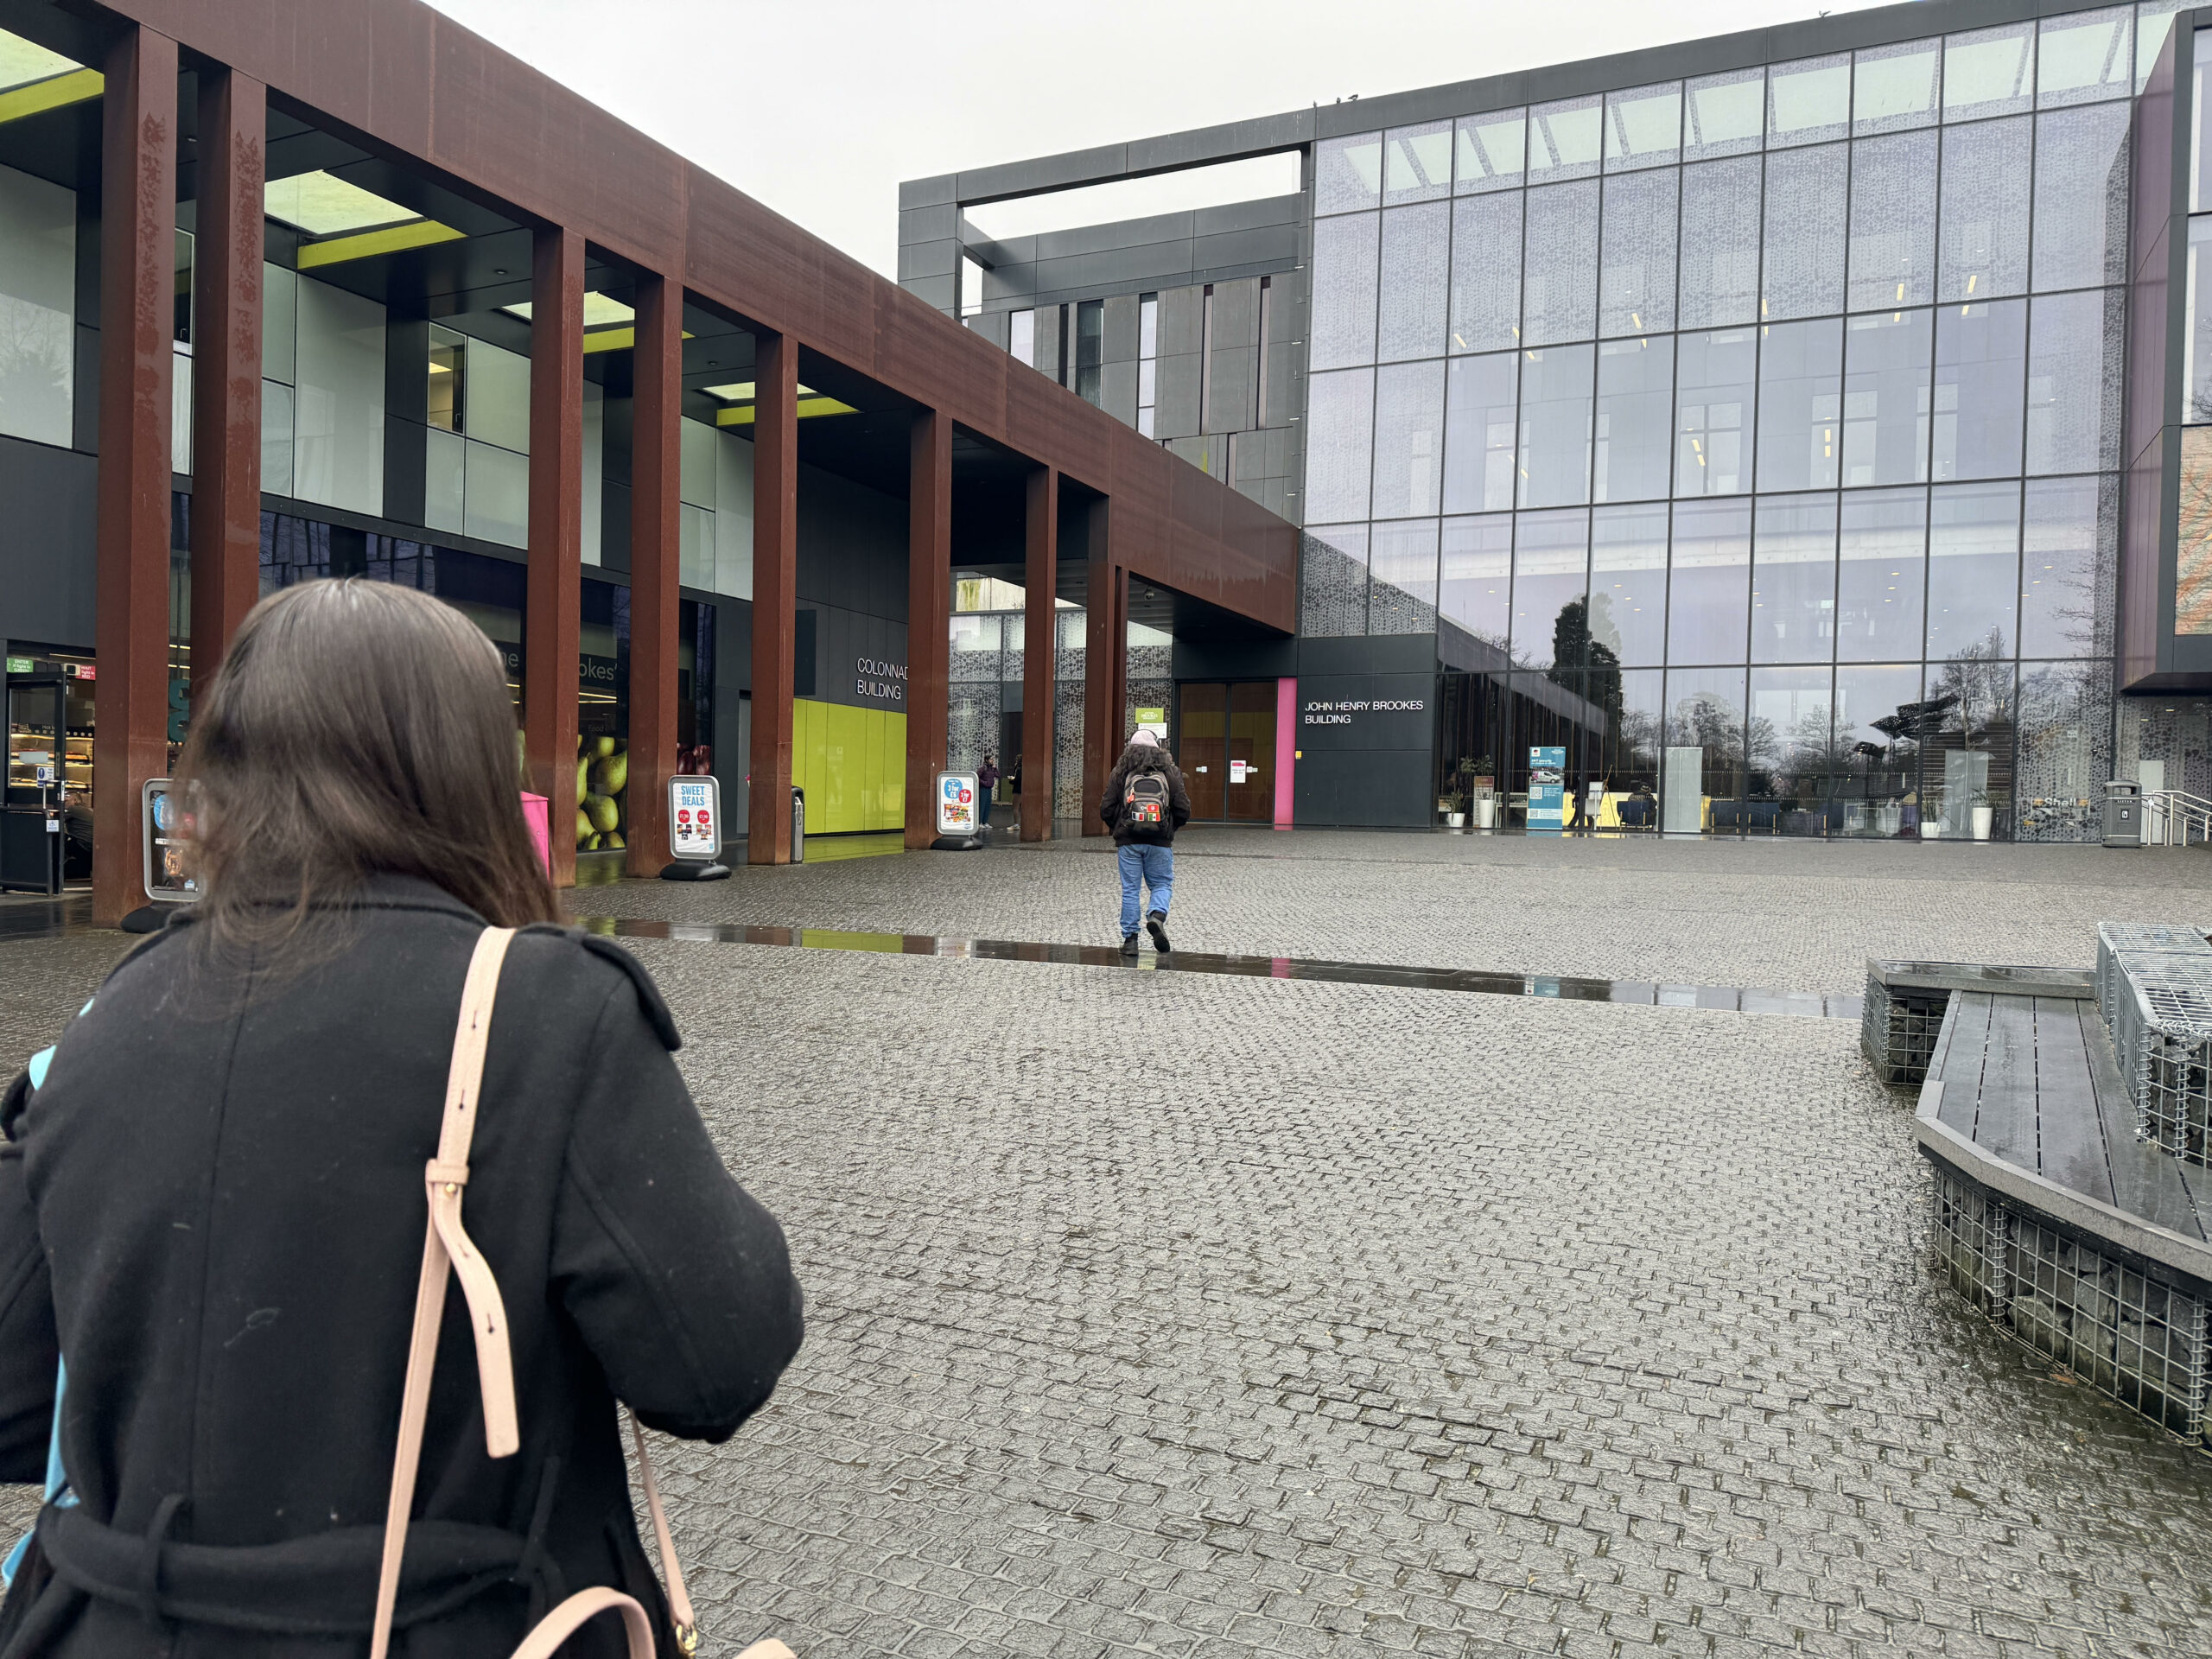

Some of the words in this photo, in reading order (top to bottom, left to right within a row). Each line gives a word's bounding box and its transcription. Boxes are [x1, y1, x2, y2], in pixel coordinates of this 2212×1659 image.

[857, 679, 901, 700] BUILDING
[1305, 702, 1332, 711] JOHN
[1335, 701, 1370, 711] HENRY
[1372, 700, 1424, 710] BROOKES
[1305, 715, 1351, 724] BUILDING
[681, 786, 705, 795] SWEET
[682, 796, 705, 806] DEALS
[2044, 798, 2076, 806] Shell
